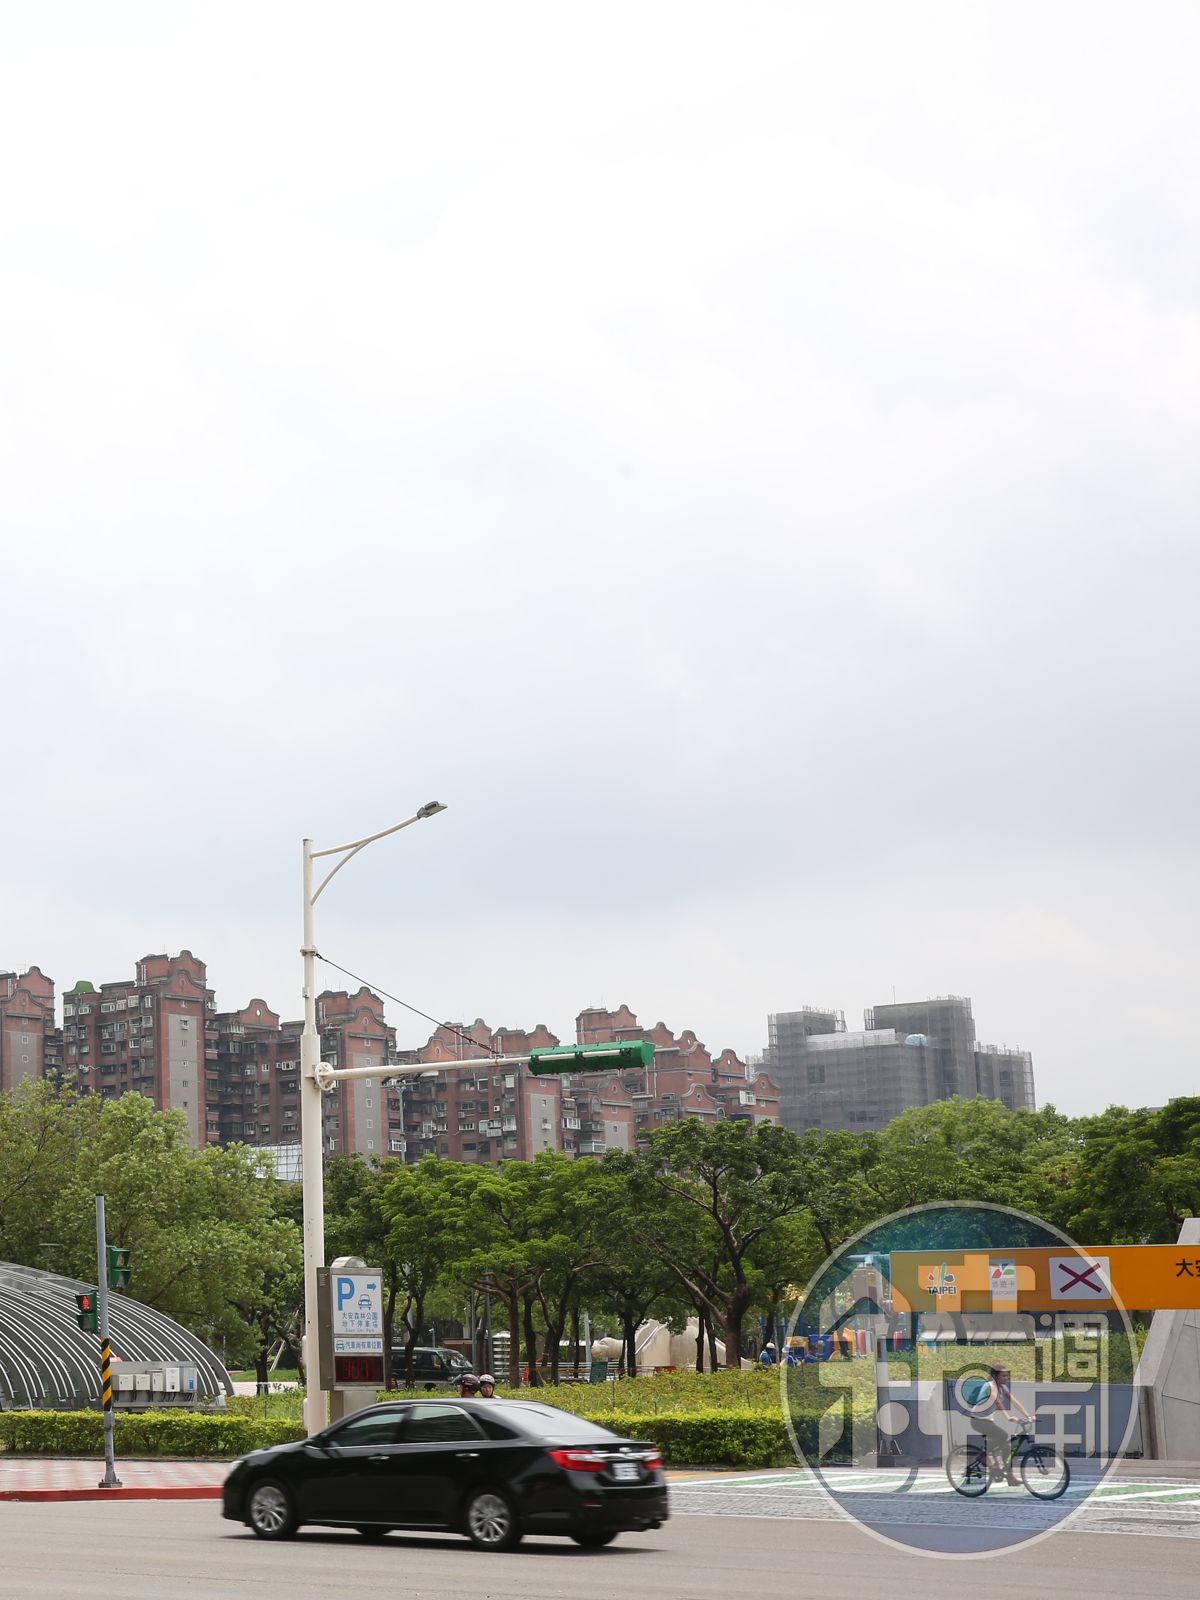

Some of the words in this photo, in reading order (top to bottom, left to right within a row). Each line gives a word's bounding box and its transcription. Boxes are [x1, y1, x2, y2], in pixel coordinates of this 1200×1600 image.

[337, 1277, 355, 1311] P
[927, 1286, 957, 1295] TAIPEI
[342, 1312, 378, 1320] 大安森林公園
